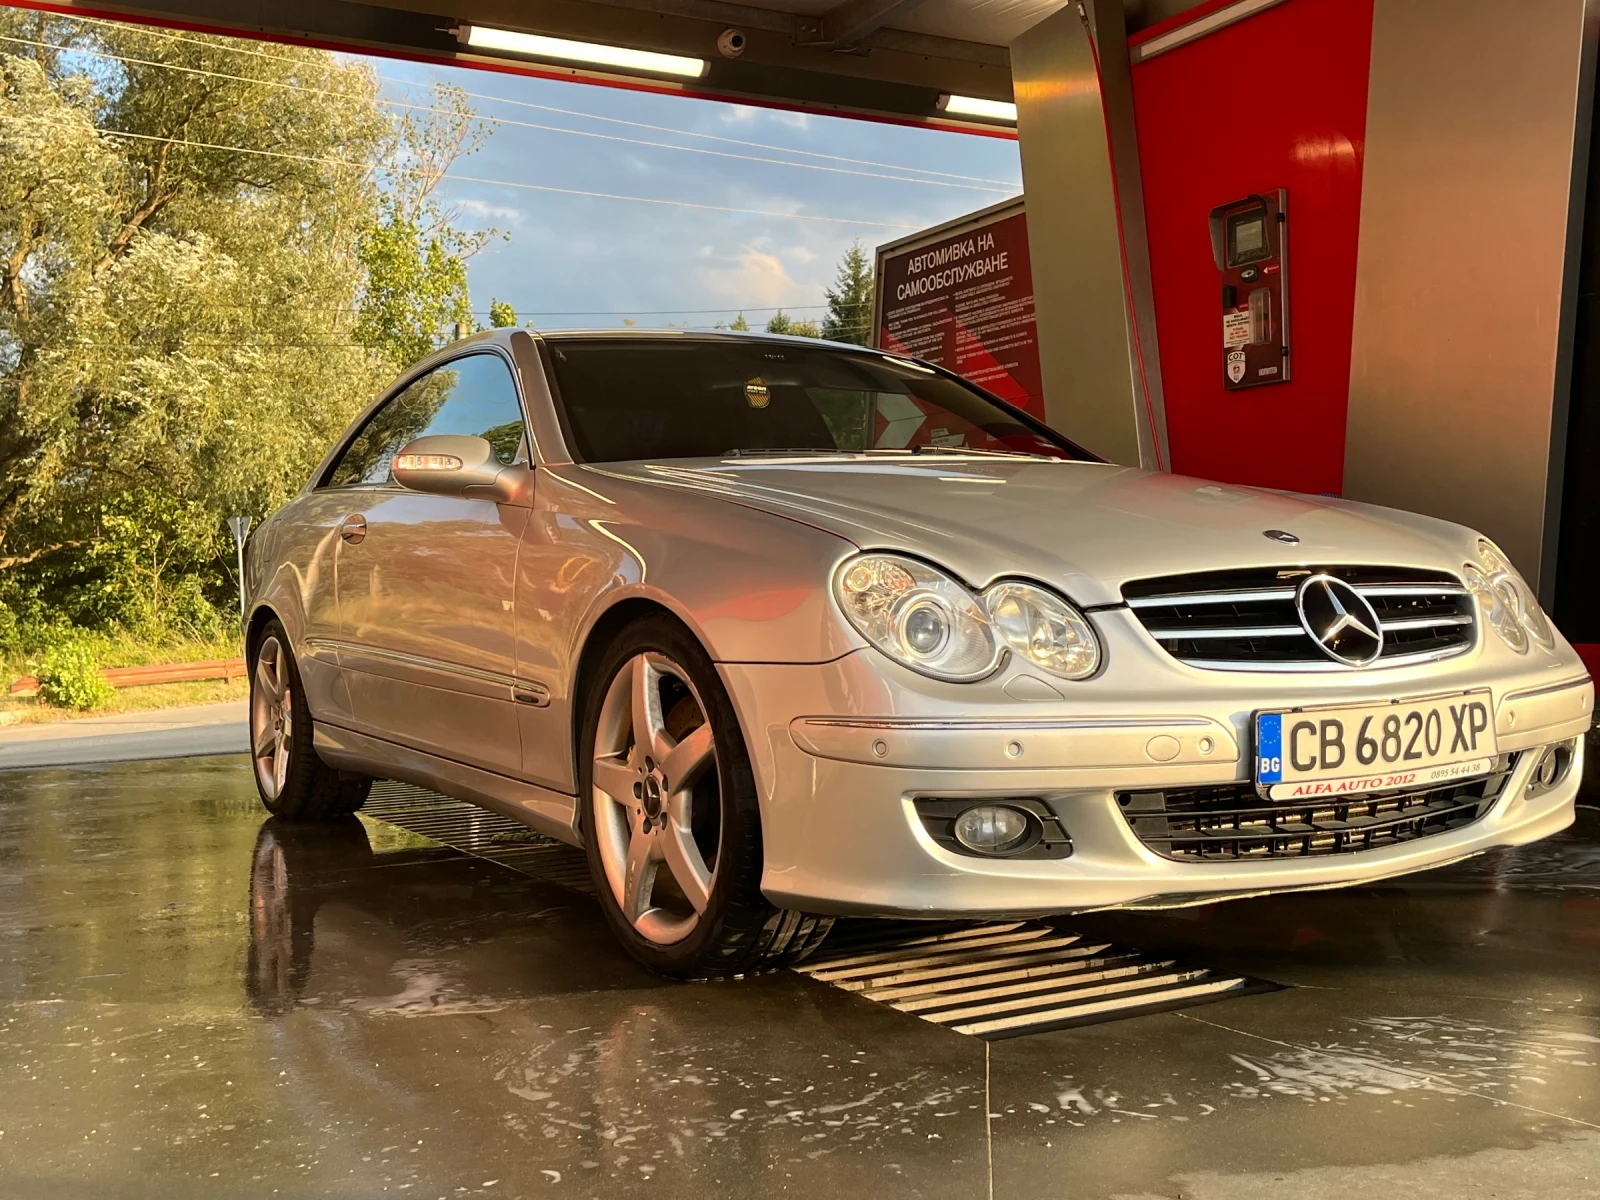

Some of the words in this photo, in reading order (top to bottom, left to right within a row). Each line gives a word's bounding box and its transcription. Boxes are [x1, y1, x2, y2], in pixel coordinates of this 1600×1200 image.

[908, 239, 975, 275] АВТОМИВКА
[977, 232, 995, 253] НА
[897, 252, 1009, 301] САМООБСЛУЖВАНЕ
[1260, 757, 1280, 774] BG
[1290, 719, 1346, 772] CB
[1355, 708, 1442, 766] 6820
[1449, 701, 1488, 754] XP
[1292, 783, 1333, 796] ALFA
[1336, 777, 1383, 792] AUTO
[1385, 773, 1416, 786] 2012
[1431, 769, 1449, 779] 0895
[1450, 766, 1460, 776] 54
[1460, 765, 1471, 774] 44
[1471, 763, 1481, 772] 38
